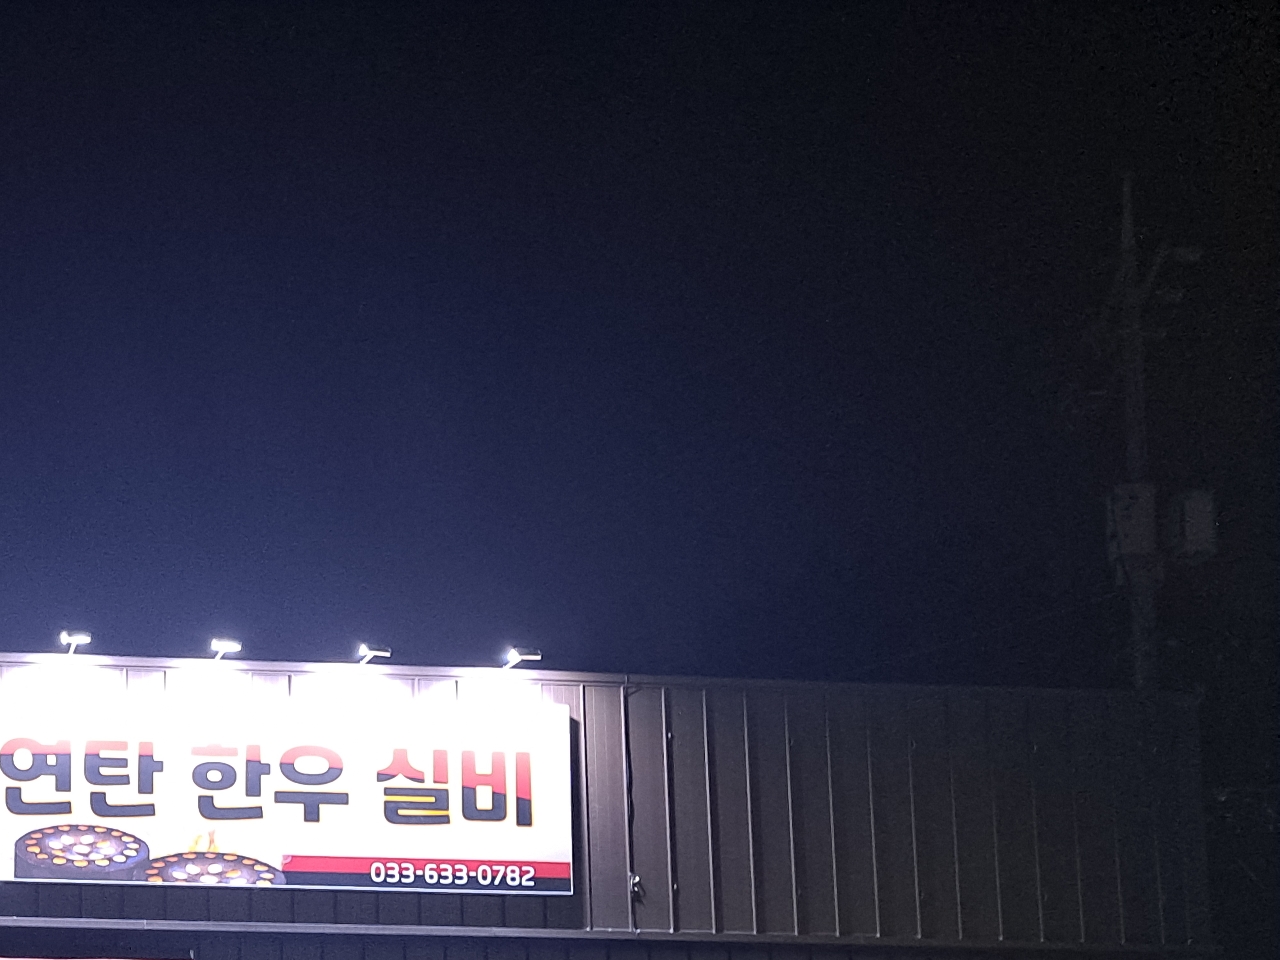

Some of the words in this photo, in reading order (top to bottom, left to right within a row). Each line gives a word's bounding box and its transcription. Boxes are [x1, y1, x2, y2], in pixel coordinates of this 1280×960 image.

[191, 743, 349, 823] 한우
[376, 748, 532, 828] 실비
[370, 861, 536, 888] 033-633-0782
